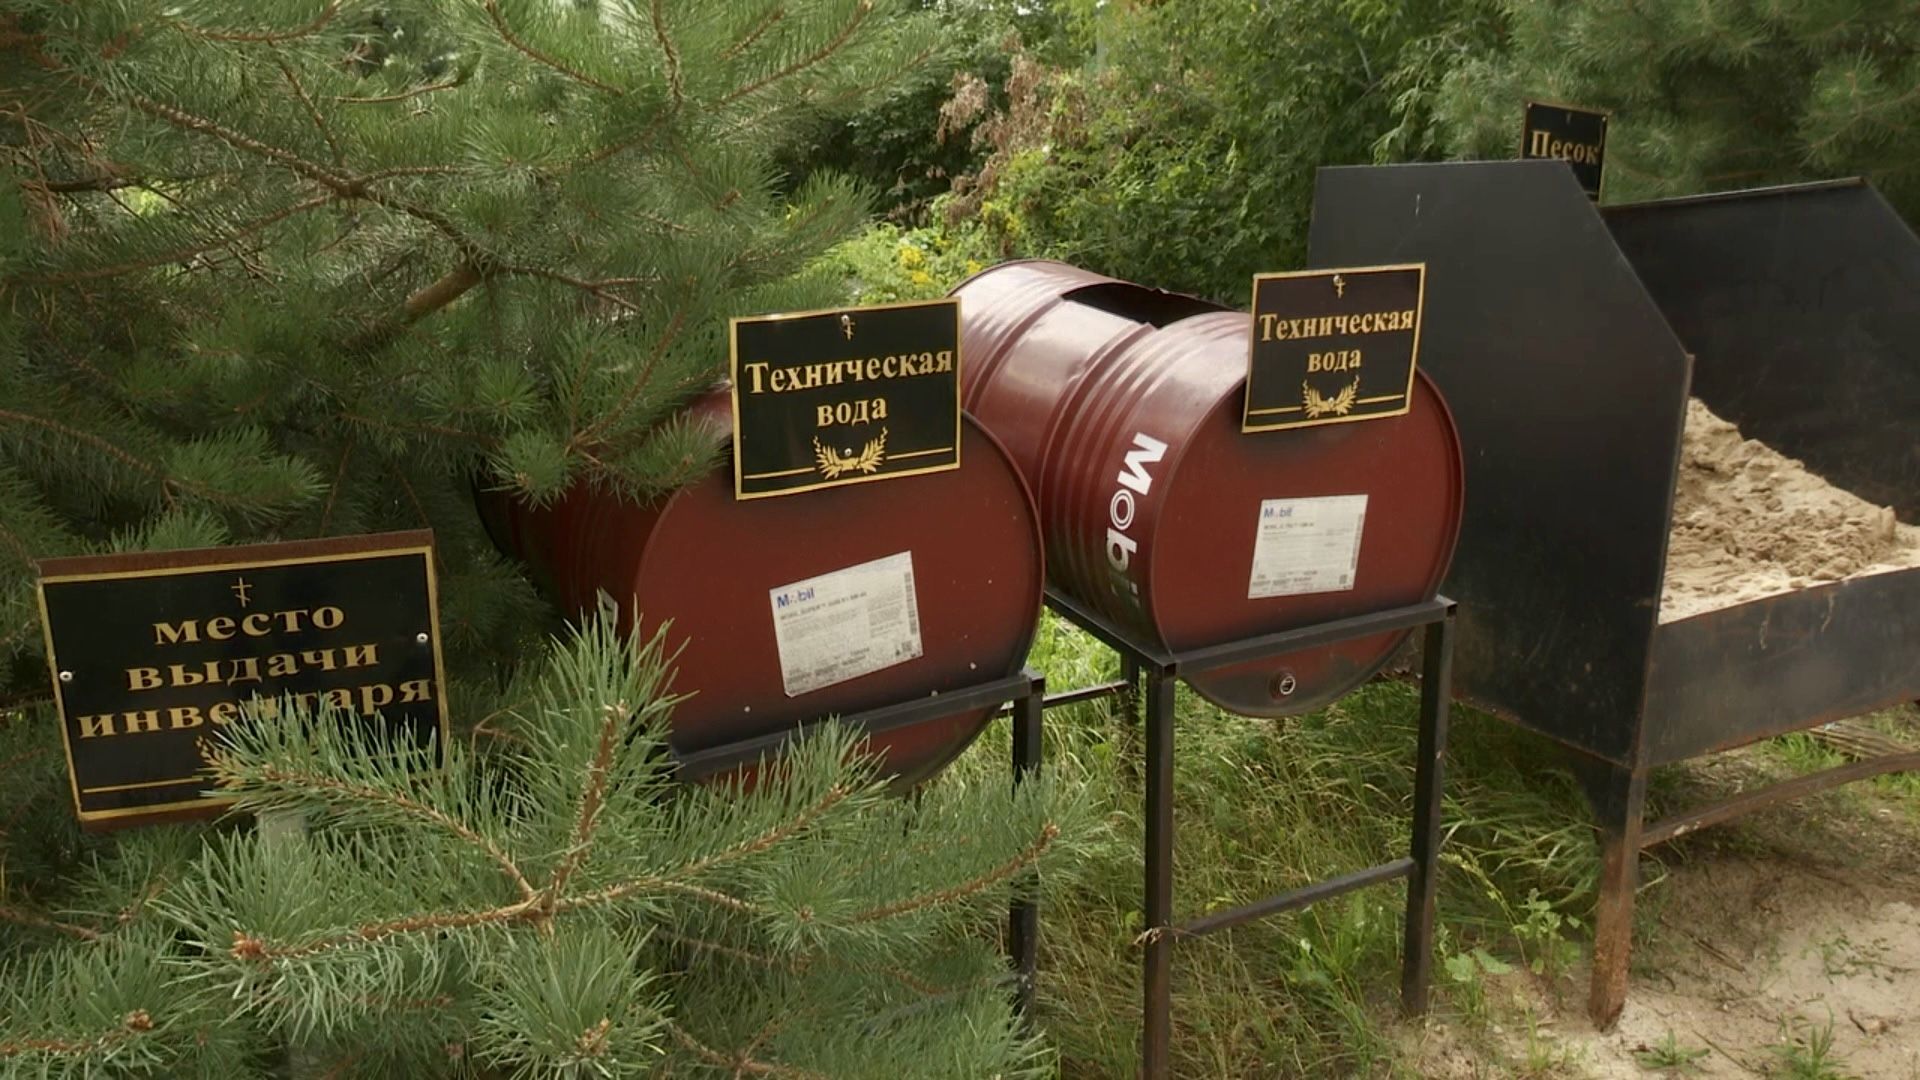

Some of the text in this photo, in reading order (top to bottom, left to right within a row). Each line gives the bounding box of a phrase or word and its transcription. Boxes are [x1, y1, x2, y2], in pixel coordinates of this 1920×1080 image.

[1530, 130, 1599, 164] Песок
[1259, 310, 1415, 341] Техническая
[744, 350, 953, 394] Техническая
[1307, 349, 1362, 373] вода
[816, 398, 888, 427] вода
[1264, 507, 1293, 519] Mbil
[152, 606, 345, 645] место
[126, 643, 380, 691] выдачи
